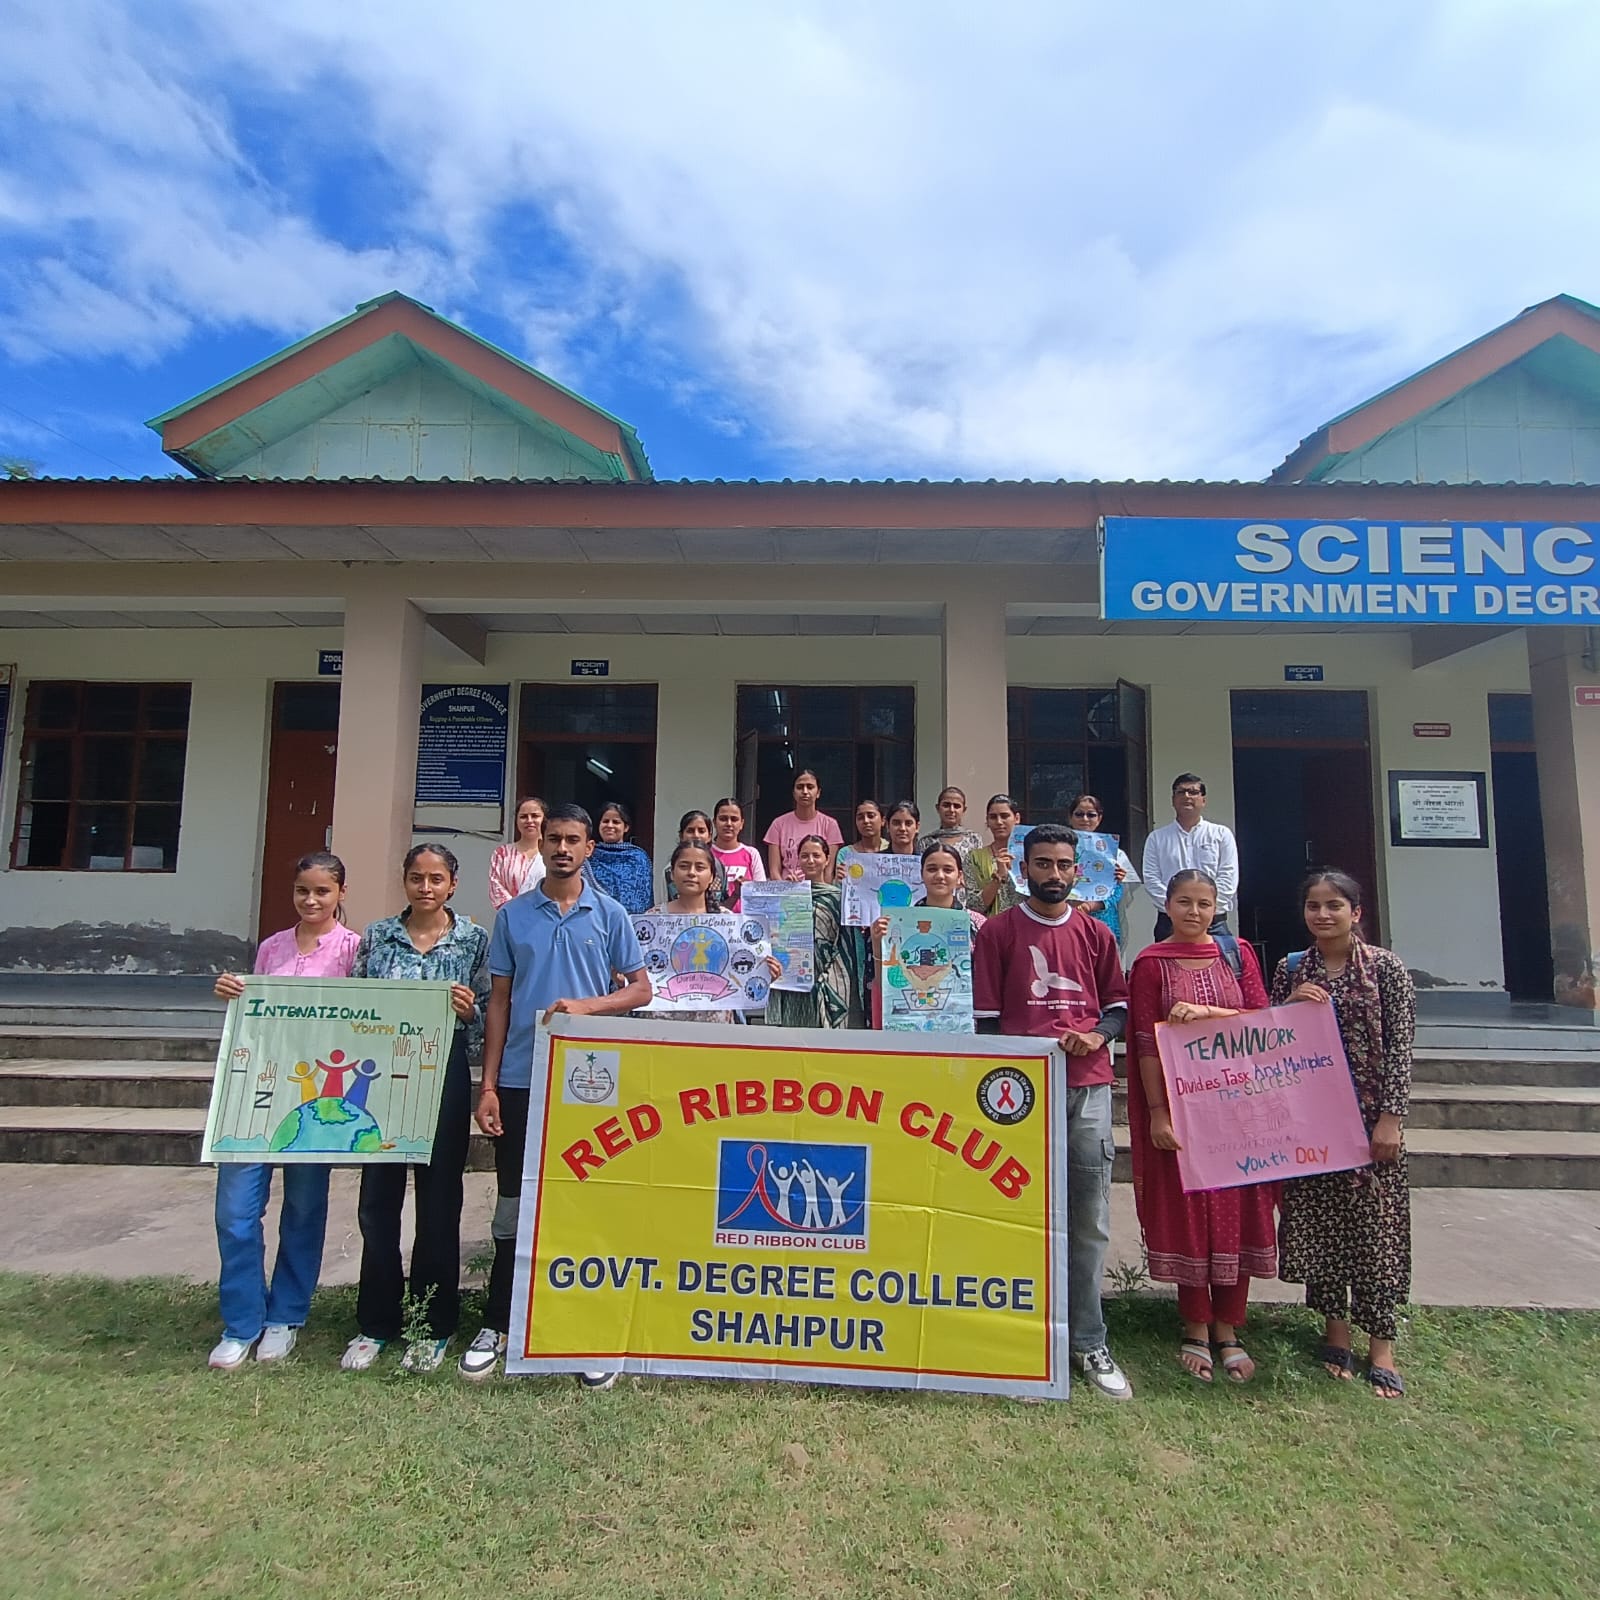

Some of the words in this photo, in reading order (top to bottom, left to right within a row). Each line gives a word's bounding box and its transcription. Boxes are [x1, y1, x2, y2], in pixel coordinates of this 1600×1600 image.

[1235, 523, 1595, 575] SCIENC
[1131, 581, 1458, 613] GOVERNMENT
[1474, 584, 1600, 615] DEGR
[448, 705, 476, 713] SHAHPUR
[457, 686, 482, 698] DEGREE
[481, 691, 508, 716] COLLEGE
[1184, 1026, 1297, 1060] TEAMWORK
[1175, 1076, 1221, 1096] Divides
[1221, 1068, 1250, 1086] Task
[1254, 1062, 1283, 1080] And
[561, 1103, 662, 1182] RED
[678, 1079, 884, 1126] RIBBON
[899, 1101, 1031, 1200] CLUB
[715, 1233, 749, 1245] RED
[754, 1235, 817, 1248] RIBBON
[821, 1238, 866, 1250] CLUB
[548, 1257, 663, 1290] GOVT.
[678, 1260, 835, 1300] DEGREE
[850, 1268, 1034, 1311] COLLEGE
[690, 1309, 885, 1352] SHAHPUR
